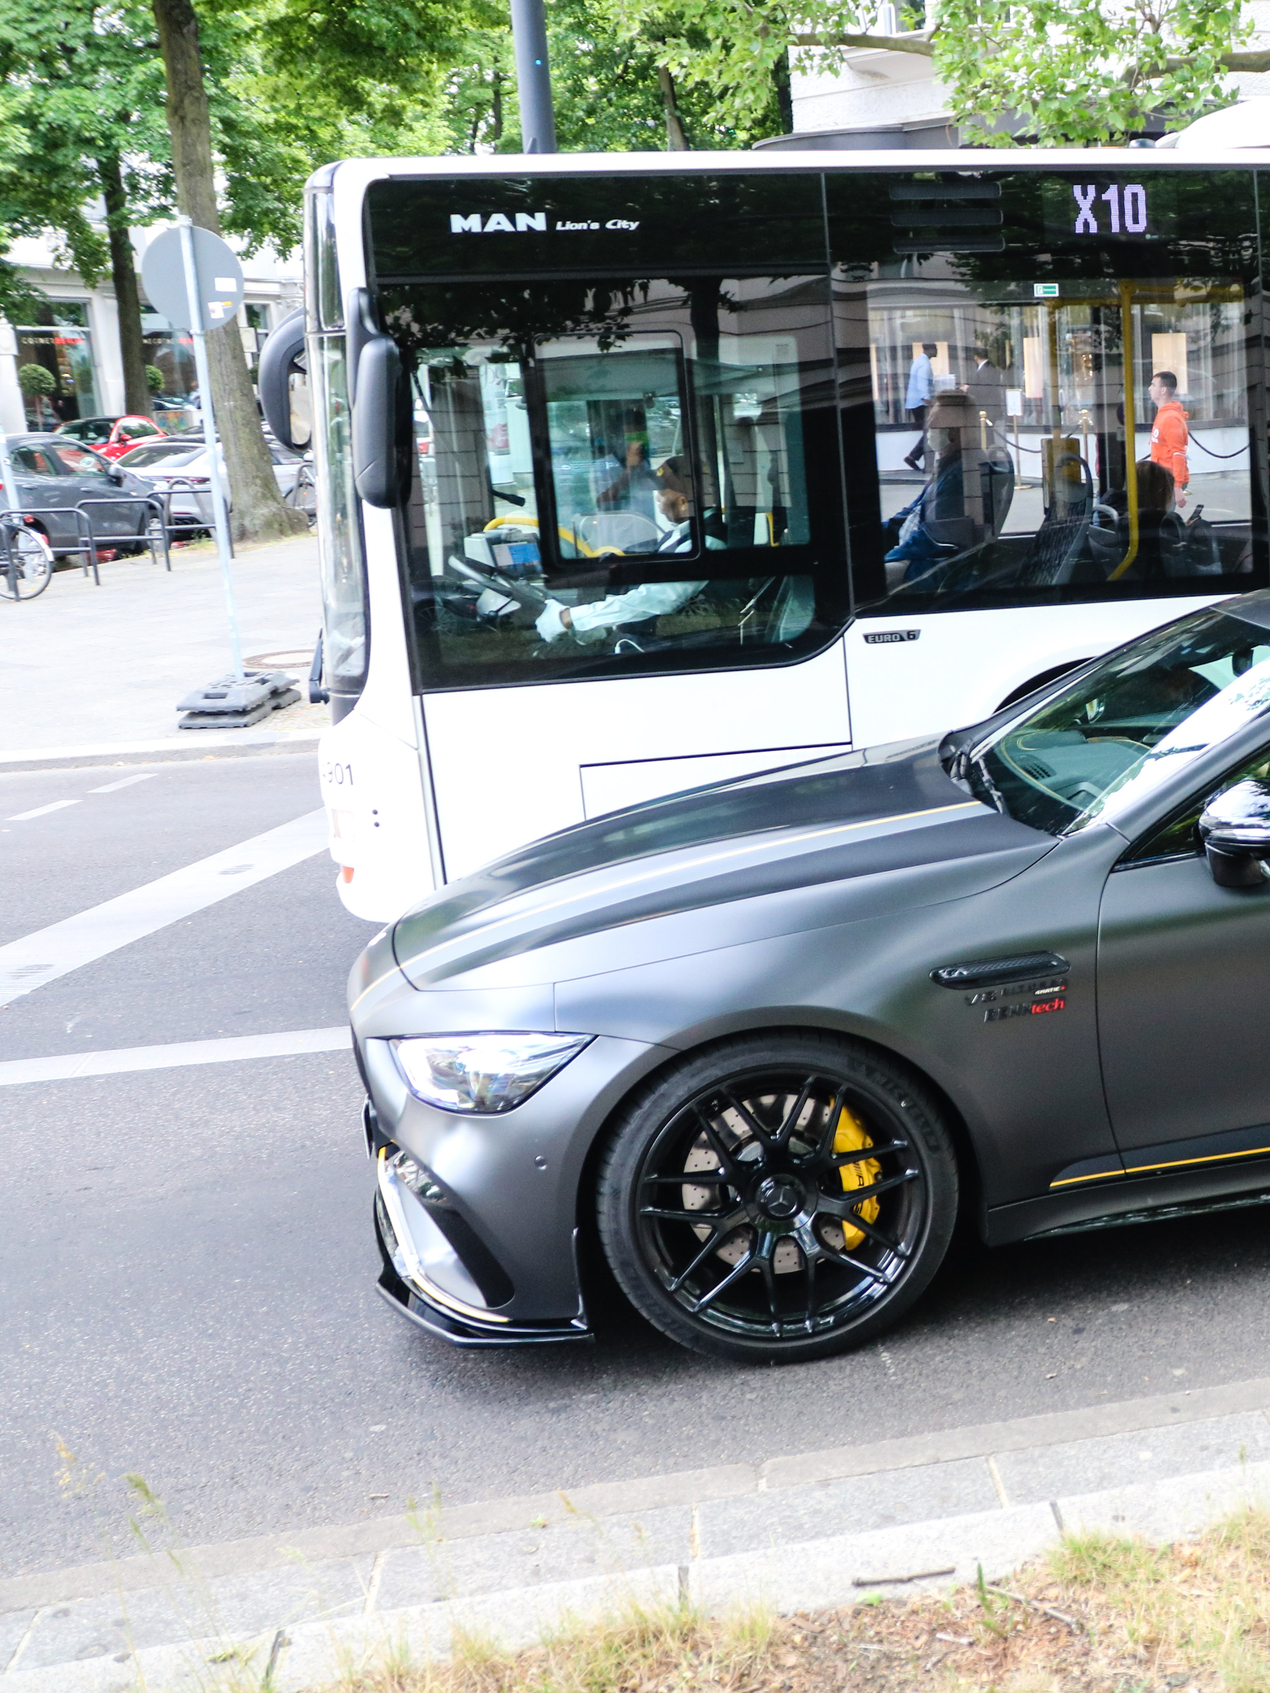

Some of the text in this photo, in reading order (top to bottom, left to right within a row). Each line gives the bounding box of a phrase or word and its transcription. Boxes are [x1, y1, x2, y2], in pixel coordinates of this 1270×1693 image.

[1073, 184, 1147, 234] X10
[450, 212, 640, 233] MAN Lion's City
[867, 630, 917, 643] EURO 6
